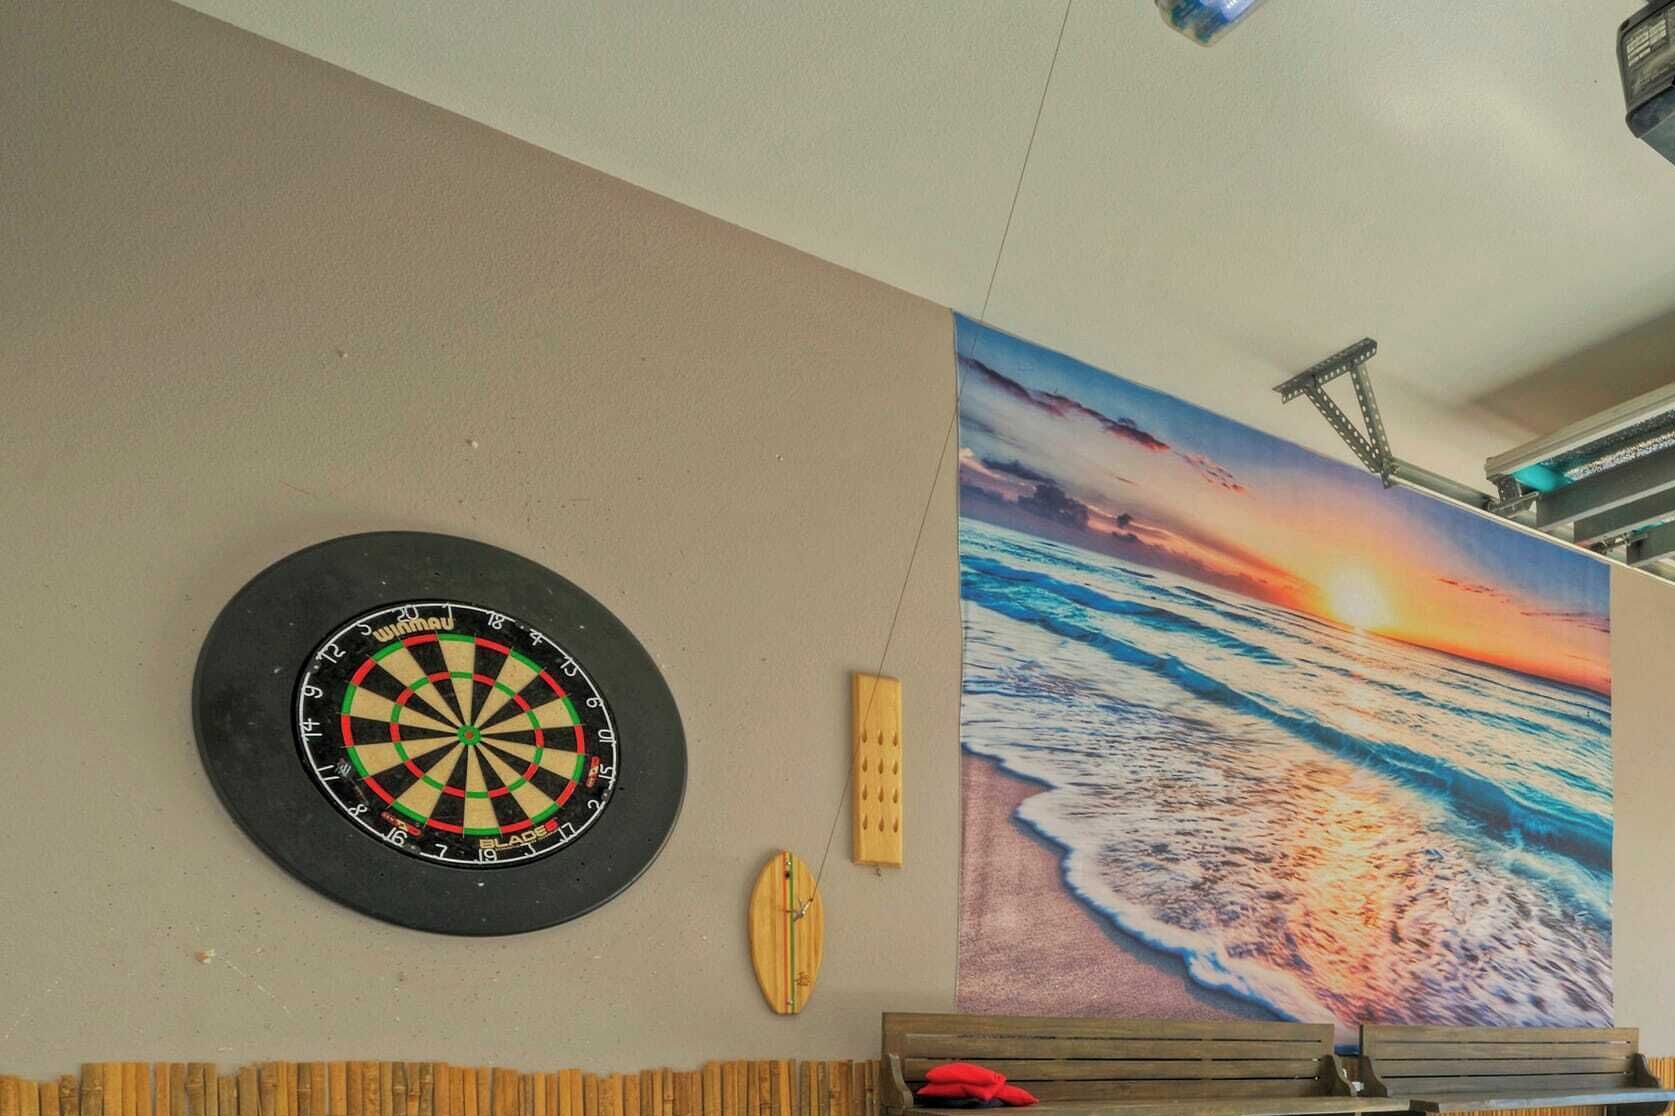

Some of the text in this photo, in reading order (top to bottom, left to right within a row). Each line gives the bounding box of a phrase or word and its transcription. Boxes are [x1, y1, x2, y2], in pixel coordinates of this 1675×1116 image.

[391, 604, 419, 623] 20
[486, 610, 506, 630] 18
[529, 628, 543, 646] 4
[319, 642, 347, 664] 12
[560, 655, 577, 677] 13
[302, 684, 323, 699] 9
[586, 696, 603, 709] 6
[302, 717, 323, 742] 14
[598, 728, 616, 745] 10
[316, 764, 341, 782] 11
[598, 763, 616, 782] 15
[348, 803, 368, 818] 8
[587, 799, 601, 811] 2
[383, 826, 409, 848] 16
[559, 821, 577, 842] 17
[434, 843, 449, 858] 7
[474, 848, 497, 864] 19
